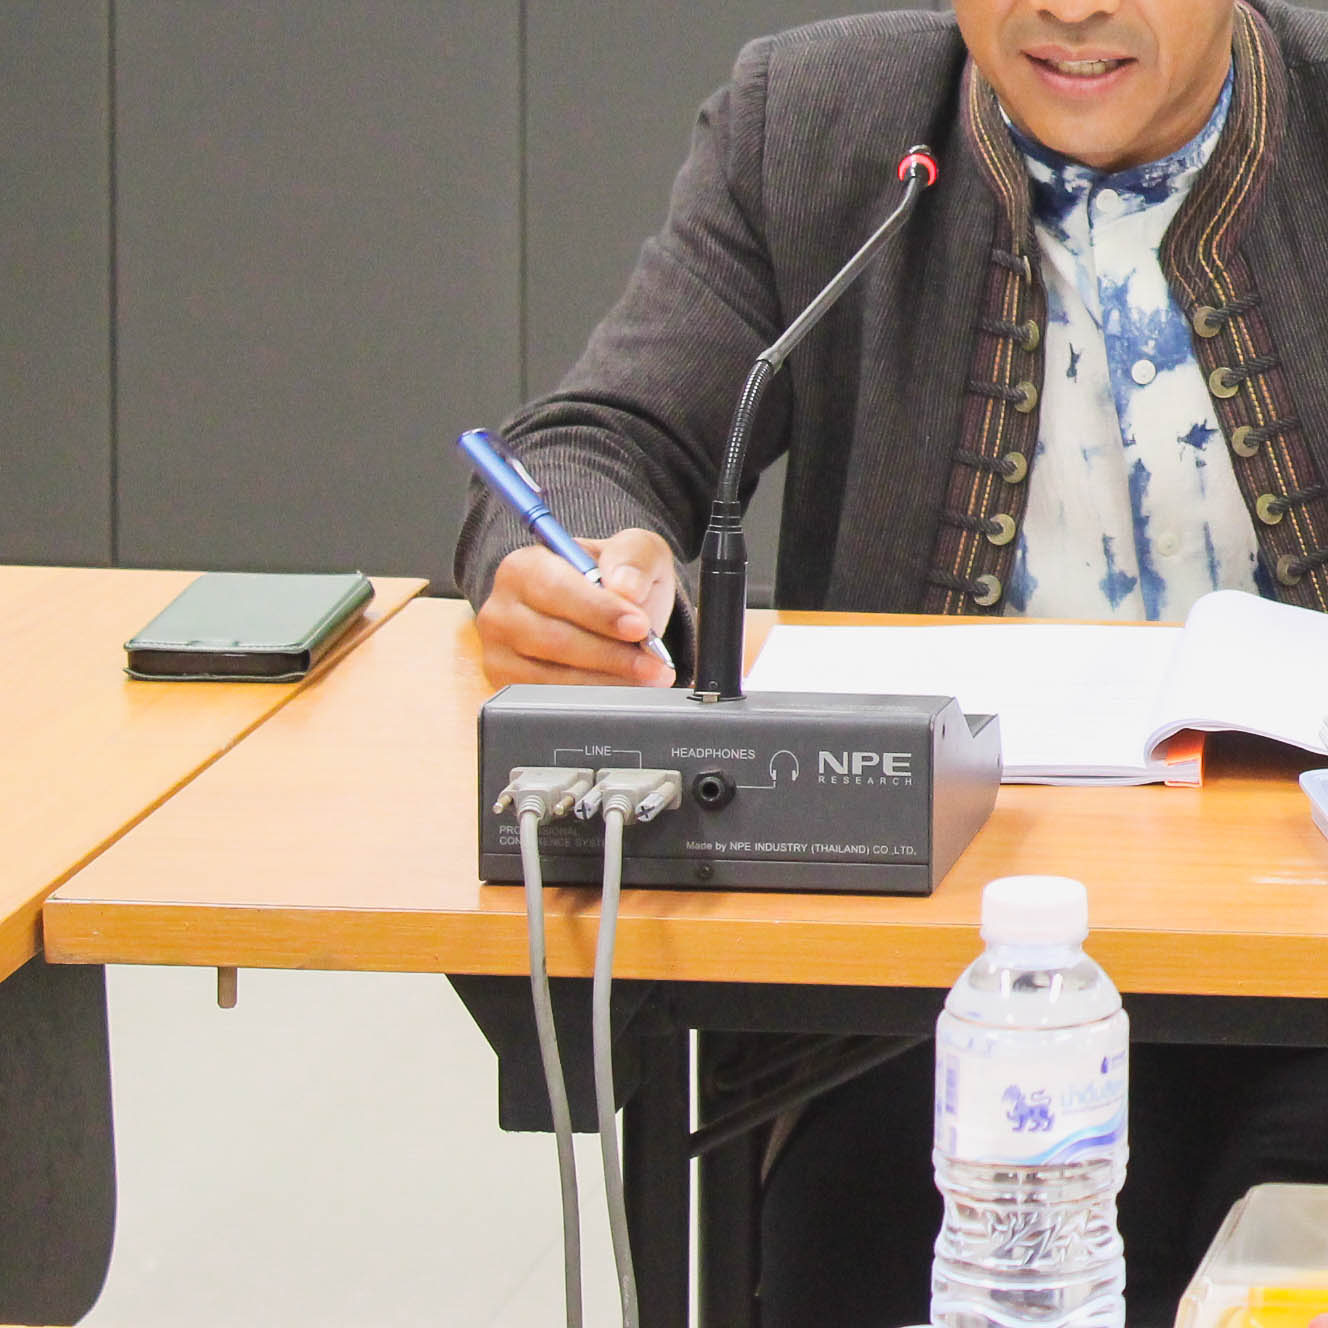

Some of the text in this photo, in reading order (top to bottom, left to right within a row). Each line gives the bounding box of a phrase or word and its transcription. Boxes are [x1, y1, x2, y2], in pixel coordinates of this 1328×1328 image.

[584, 745, 612, 757] LINE
[671, 747, 756, 760] HEADPHONES
[818, 750, 912, 776] NPE
[818, 775, 912, 786] RESEARCH
[686, 840, 712, 850] Made
[715, 841, 727, 853] by
[729, 841, 751, 851] NPE
[754, 842, 808, 853] INDUSTRY
[811, 843, 870, 855] (THAILAND)
